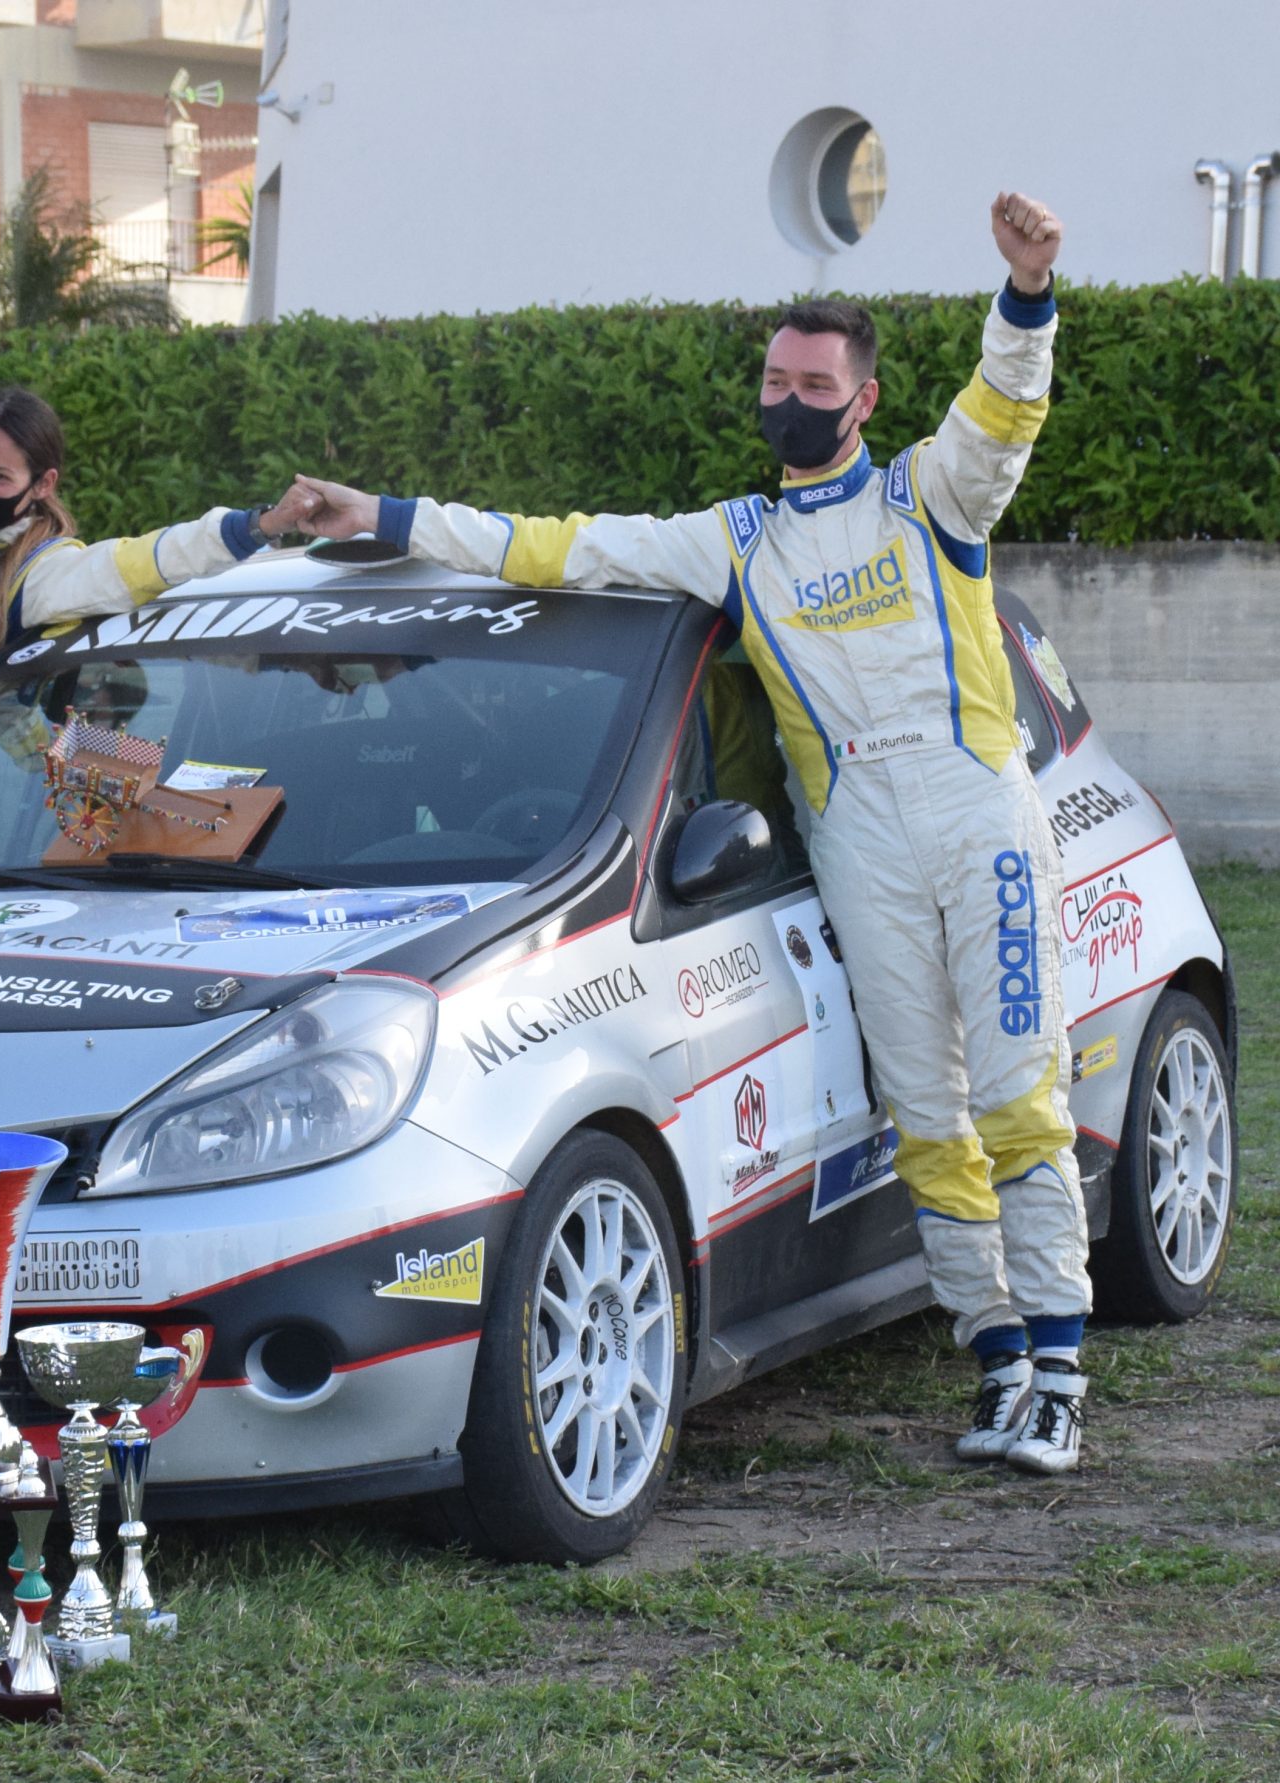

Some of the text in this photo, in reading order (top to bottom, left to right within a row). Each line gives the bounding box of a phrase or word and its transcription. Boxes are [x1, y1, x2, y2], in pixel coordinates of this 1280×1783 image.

[800, 483, 844, 504] sparco
[793, 548, 904, 611] island
[281, 597, 540, 634] Racing
[867, 733, 924, 753] M.Runfola
[302, 907, 347, 926] 10
[994, 850, 1041, 1036] sparco
[1089, 911, 1142, 999] group
[697, 942, 761, 998] ROMEO
[542, 963, 648, 1031] NAUTICA
[398, 1245, 478, 1284] Island
[401, 1274, 479, 1295] motorsport
